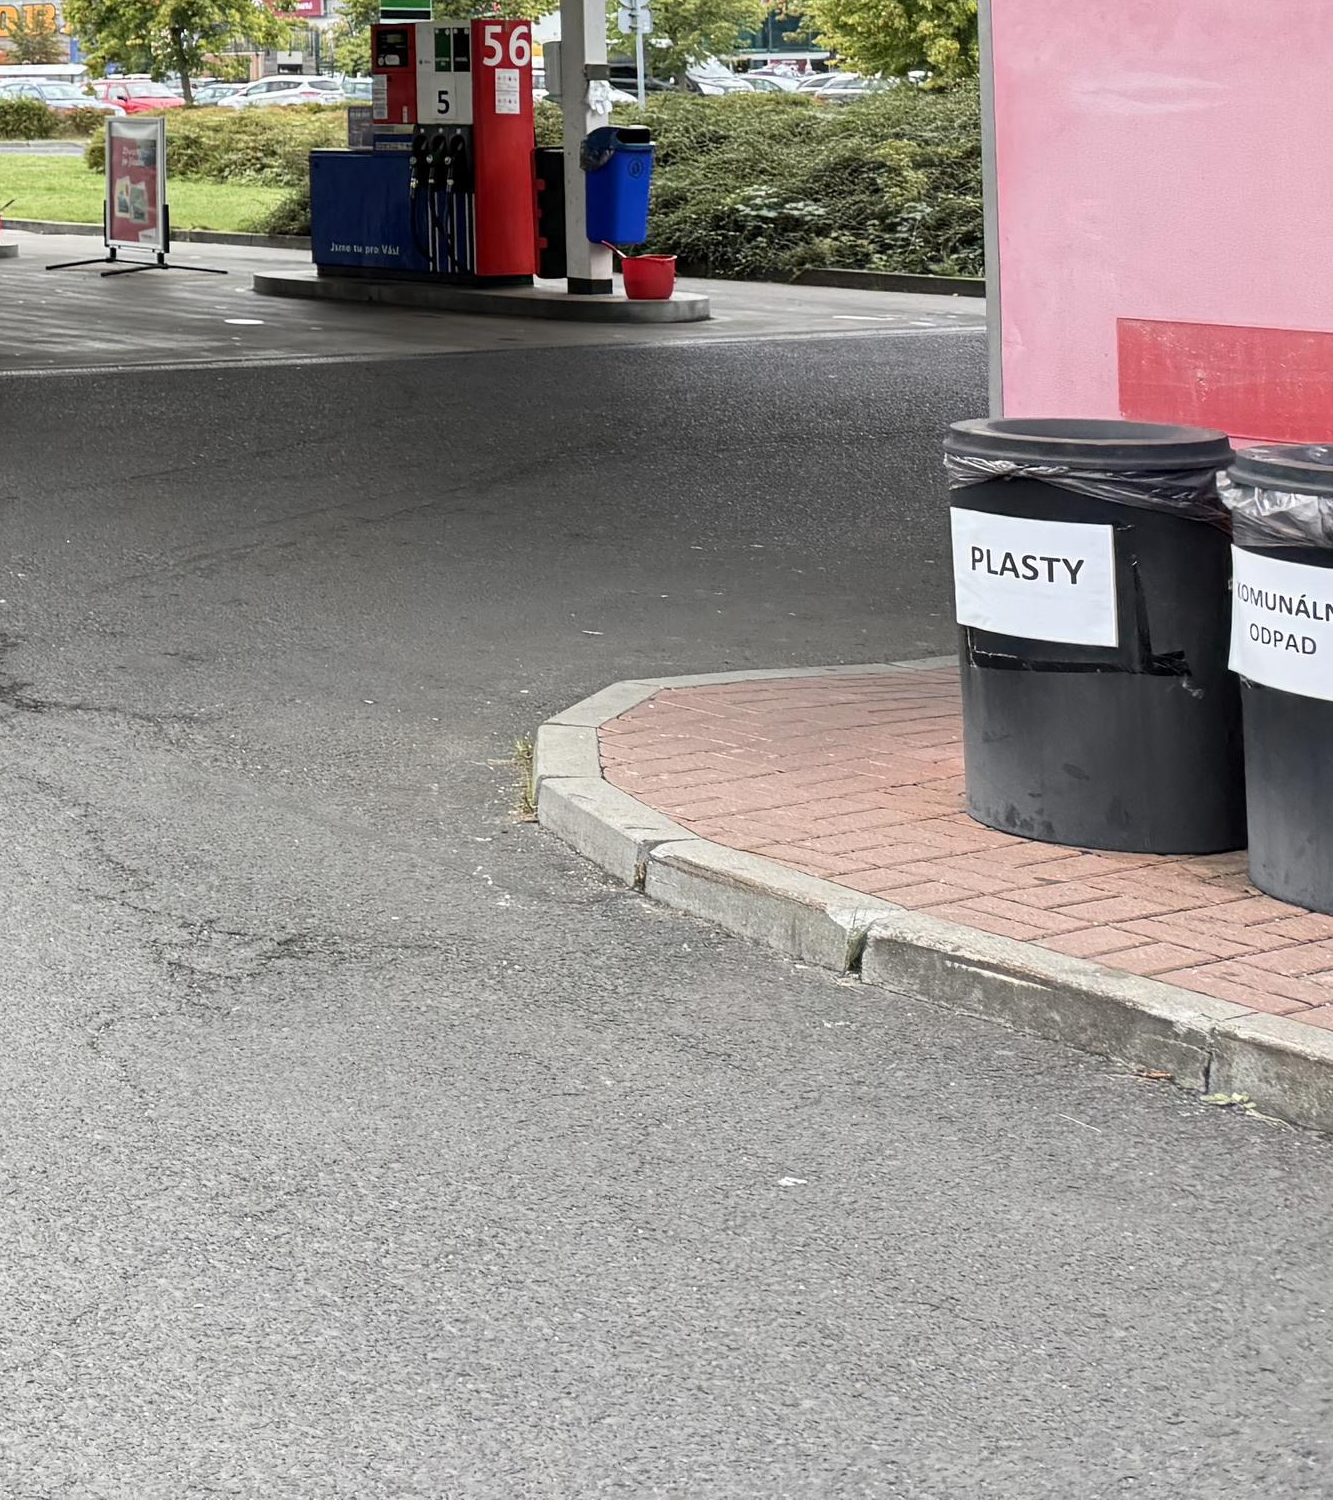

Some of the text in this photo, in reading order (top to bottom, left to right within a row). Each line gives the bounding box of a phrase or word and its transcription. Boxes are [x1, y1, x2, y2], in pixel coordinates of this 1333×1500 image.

[437, 90, 450, 115] 5
[971, 546, 1084, 584] PLASTY
[1249, 623, 1317, 655] ODPAD
